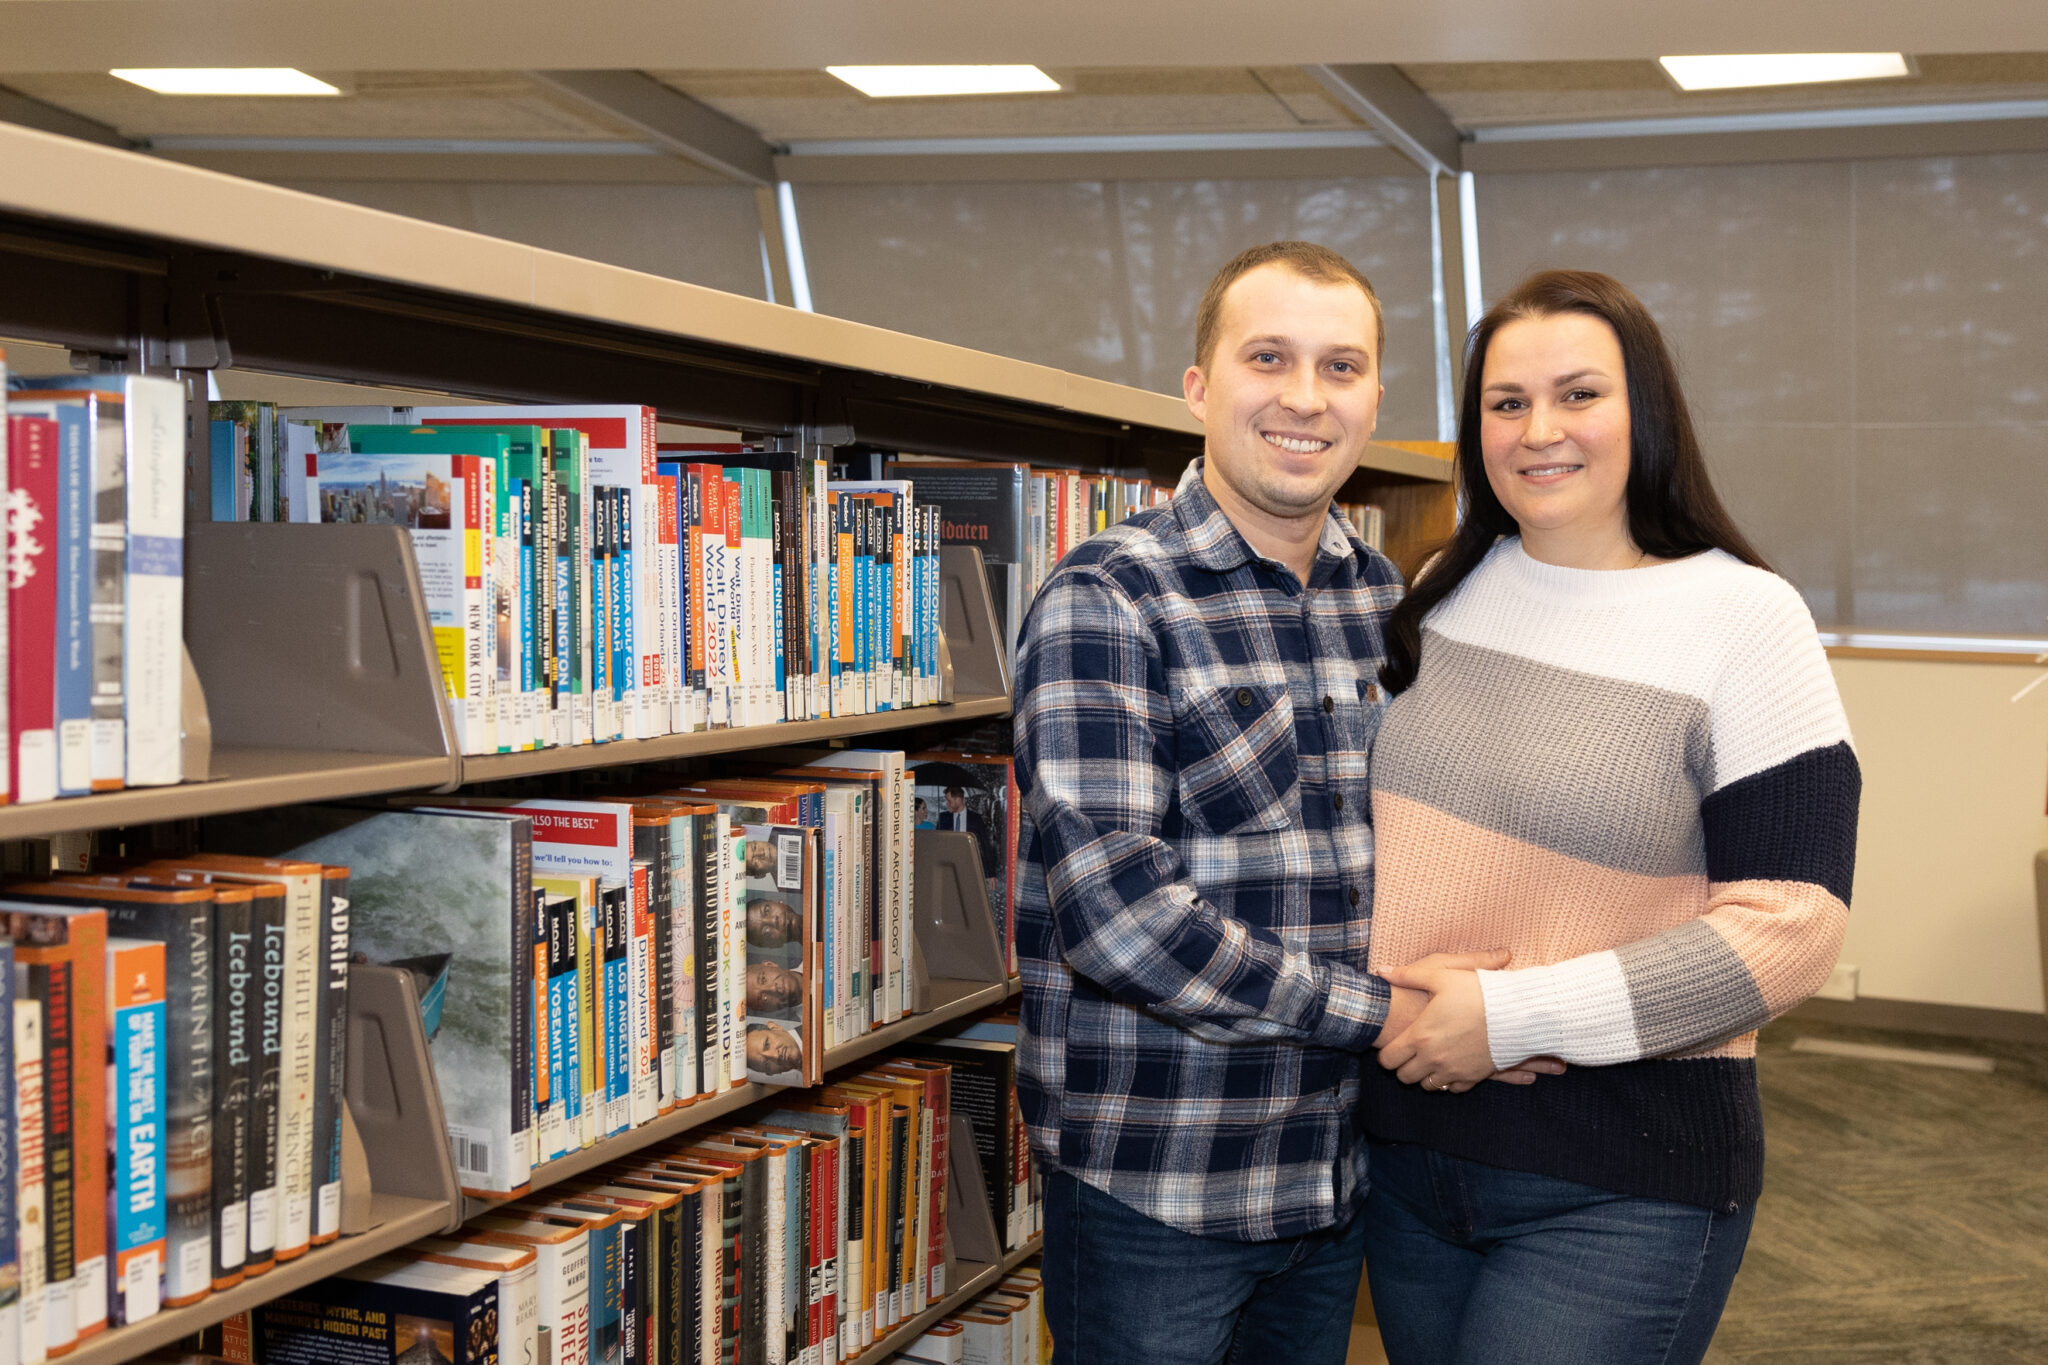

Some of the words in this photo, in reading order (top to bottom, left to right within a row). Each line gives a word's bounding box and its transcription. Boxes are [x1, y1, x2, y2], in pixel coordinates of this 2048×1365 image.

[523, 486, 532, 535] MOON
[559, 495, 568, 543] MOON
[596, 500, 604, 547] MOON
[611, 499, 619, 544] MOON
[622, 495, 631, 543] MOON
[525, 549, 533, 591] HUDSON
[597, 564, 605, 608] NORTH
[623, 553, 632, 614] FLORIDA
[658, 549, 666, 608] Universal
[683, 538, 691, 590] DISNEY
[705, 544, 716, 613] World
[716, 544, 726, 595] Walt
[734, 555, 742, 589] Walt
[894, 538, 904, 625] COLORADO
[525, 593, 533, 629] VALLEY
[612, 562, 621, 653] SAVANNAH
[695, 567, 703, 614] DISNEY
[730, 576, 738, 620] World
[774, 567, 784, 658] TENNESSEE
[811, 566, 819, 635] CHICAGO
[830, 566, 840, 662] MICHIGAN
[921, 558, 930, 636] ARIZONA
[931, 557, 941, 635] ARIZONA
[469, 604, 481, 631] NEW
[525, 631, 533, 639] &
[557, 560, 570, 687] WASHINGTON
[624, 616, 633, 655] GULF
[659, 612, 667, 665] Orlando
[717, 604, 728, 677] Disney
[735, 593, 743, 641] Disney
[469, 637, 481, 668] YORK
[525, 641, 533, 659] THE
[707, 621, 718, 679] 2022
[469, 672, 481, 698] CITY
[552, 816, 571, 829] THE
[892, 767, 901, 847] INCREDIBLE
[534, 853, 553, 862] we'll
[554, 854, 567, 864] tell
[567, 857, 583, 866] you
[583, 857, 600, 866] how
[601, 858, 614, 867] to:
[295, 892, 312, 940] THE
[705, 851, 718, 941] MADHOUSE
[892, 850, 901, 958] ARCHAEOLOGY
[329, 895, 350, 992] ADRIFT
[552, 917, 560, 964] MOON
[568, 911, 576, 958] MOON
[606, 903, 614, 950] MOON
[619, 901, 627, 946] MOON
[648, 919, 656, 938] BIG
[721, 909, 731, 974] BOOK
[262, 922, 287, 1058] Icebound
[294, 943, 312, 1025] WHITE
[538, 950, 547, 990] NAPA
[583, 951, 592, 1014] YOSEMITE
[607, 965, 615, 997] DEATH
[617, 961, 627, 995] LOS
[637, 939, 650, 1039] Disneyland
[649, 985, 657, 1002] OF
[706, 960, 718, 992] END
[722, 977, 730, 995] OF
[189, 915, 208, 1080] LABYRINTH
[228, 931, 253, 1069] Icebound
[539, 994, 548, 1006] &
[567, 974, 578, 1068] YOSEMITE
[608, 999, 616, 1034] VALLEY
[539, 1009, 549, 1079] SONOMA
[551, 981, 563, 1075] YOSEMITE
[618, 999, 628, 1075] ANGELES
[721, 1000, 731, 1062] PRIDE
[294, 1030, 312, 1086] SHIP
[609, 1035, 617, 1082] NATIONAL
[18, 1058, 45, 1193] ELSEWHERE
[190, 1115, 209, 1167] ICE
[233, 1114, 245, 1178] ANDREA
[265, 1104, 276, 1166] ANDREA
[127, 1121, 157, 1215] EARTH
[284, 1110, 301, 1198] SPENCER
[627, 1247, 635, 1282] TAKEI
[670, 1238, 682, 1325] CHASING
[714, 1246, 724, 1302] Hitler's
[360, 1325, 389, 1341] PAST
